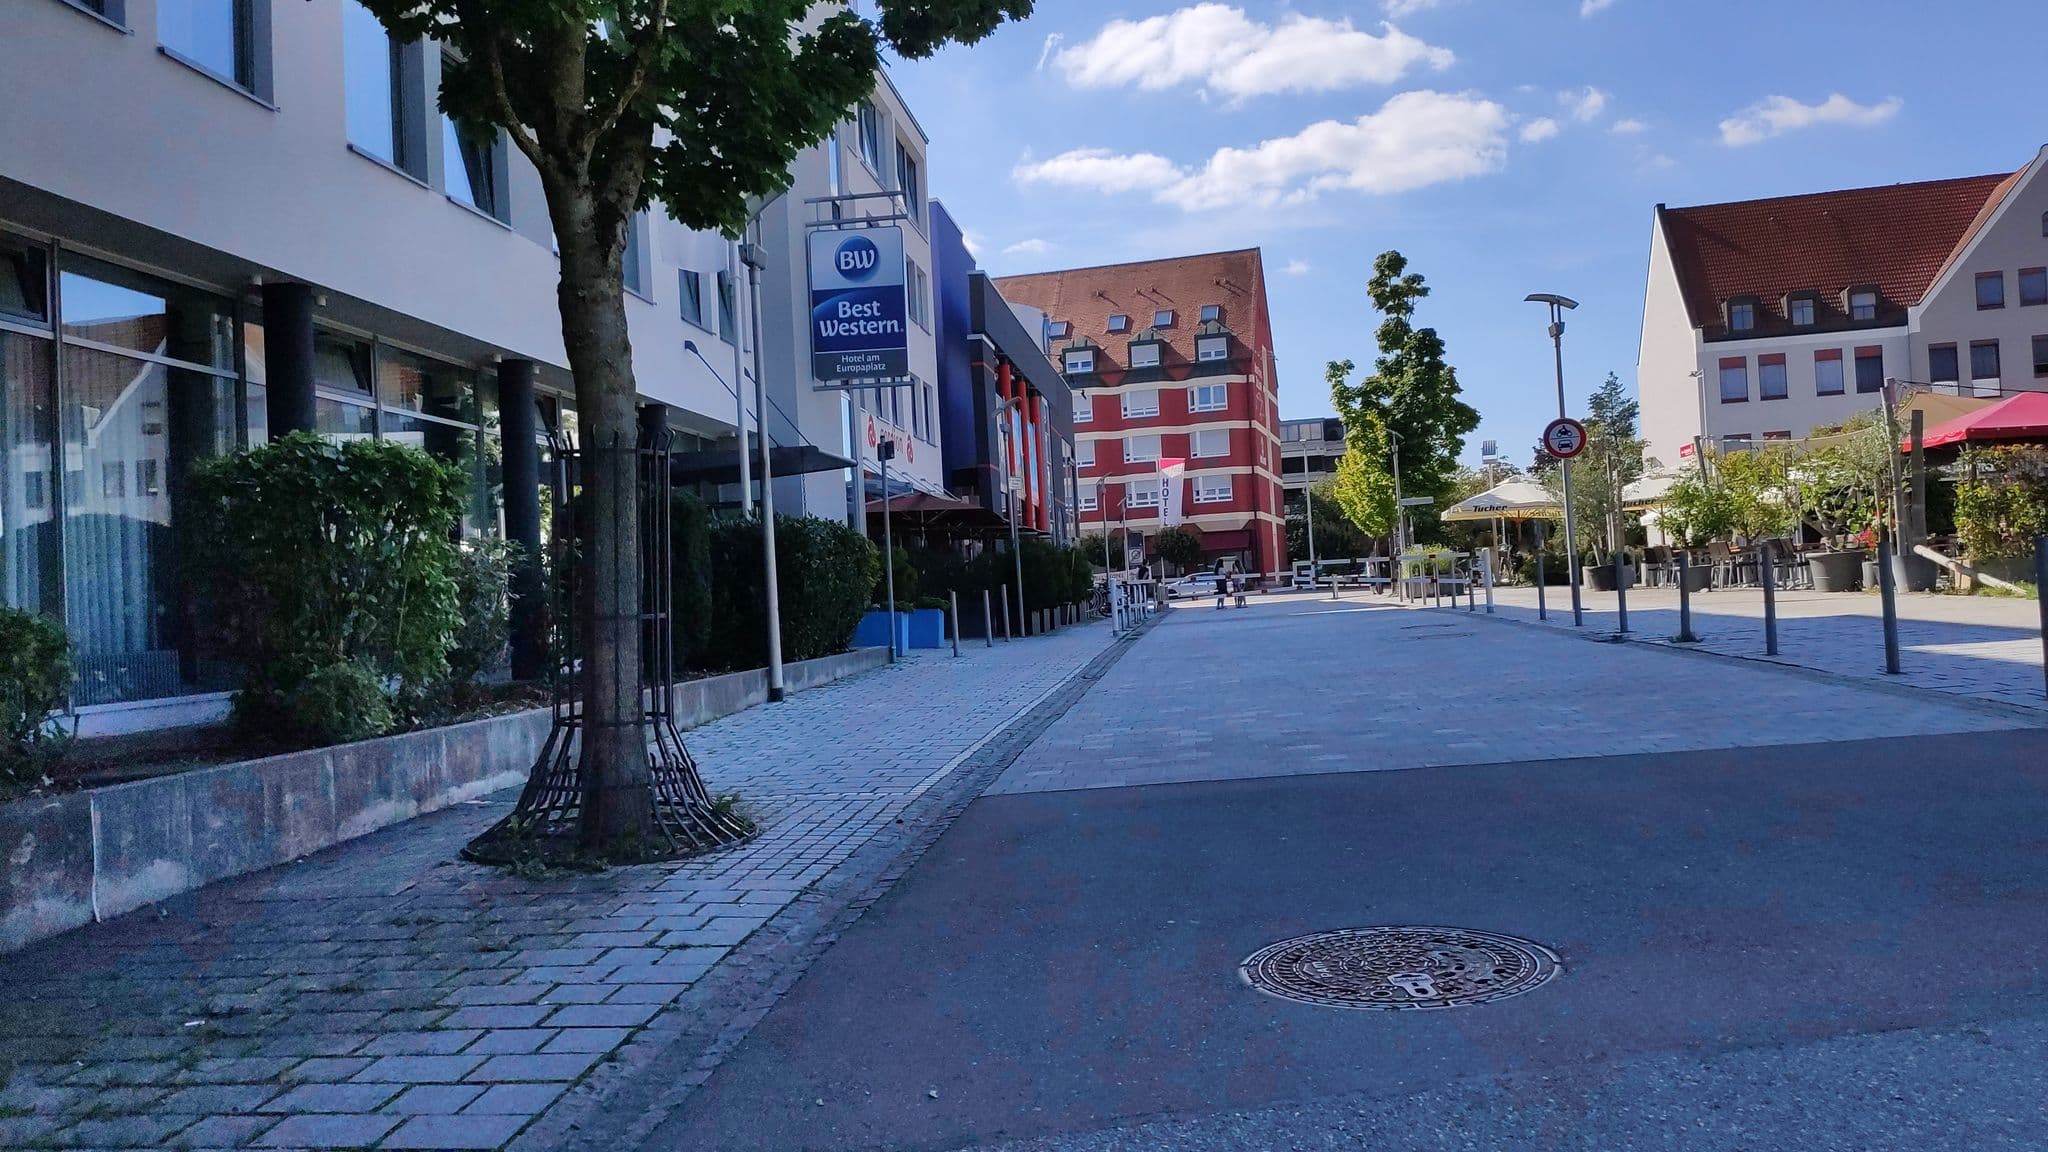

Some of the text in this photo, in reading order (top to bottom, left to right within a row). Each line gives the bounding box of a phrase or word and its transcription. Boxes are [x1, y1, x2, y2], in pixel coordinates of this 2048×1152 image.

[840, 249, 875, 270] BW
[838, 301, 880, 318] Best
[819, 319, 899, 337] Western
[841, 354, 864, 363] Hotel
[836, 362, 886, 373] Europaplatz
[1162, 478, 1170, 526] HOTEL
[1473, 504, 1507, 512] Tucher
